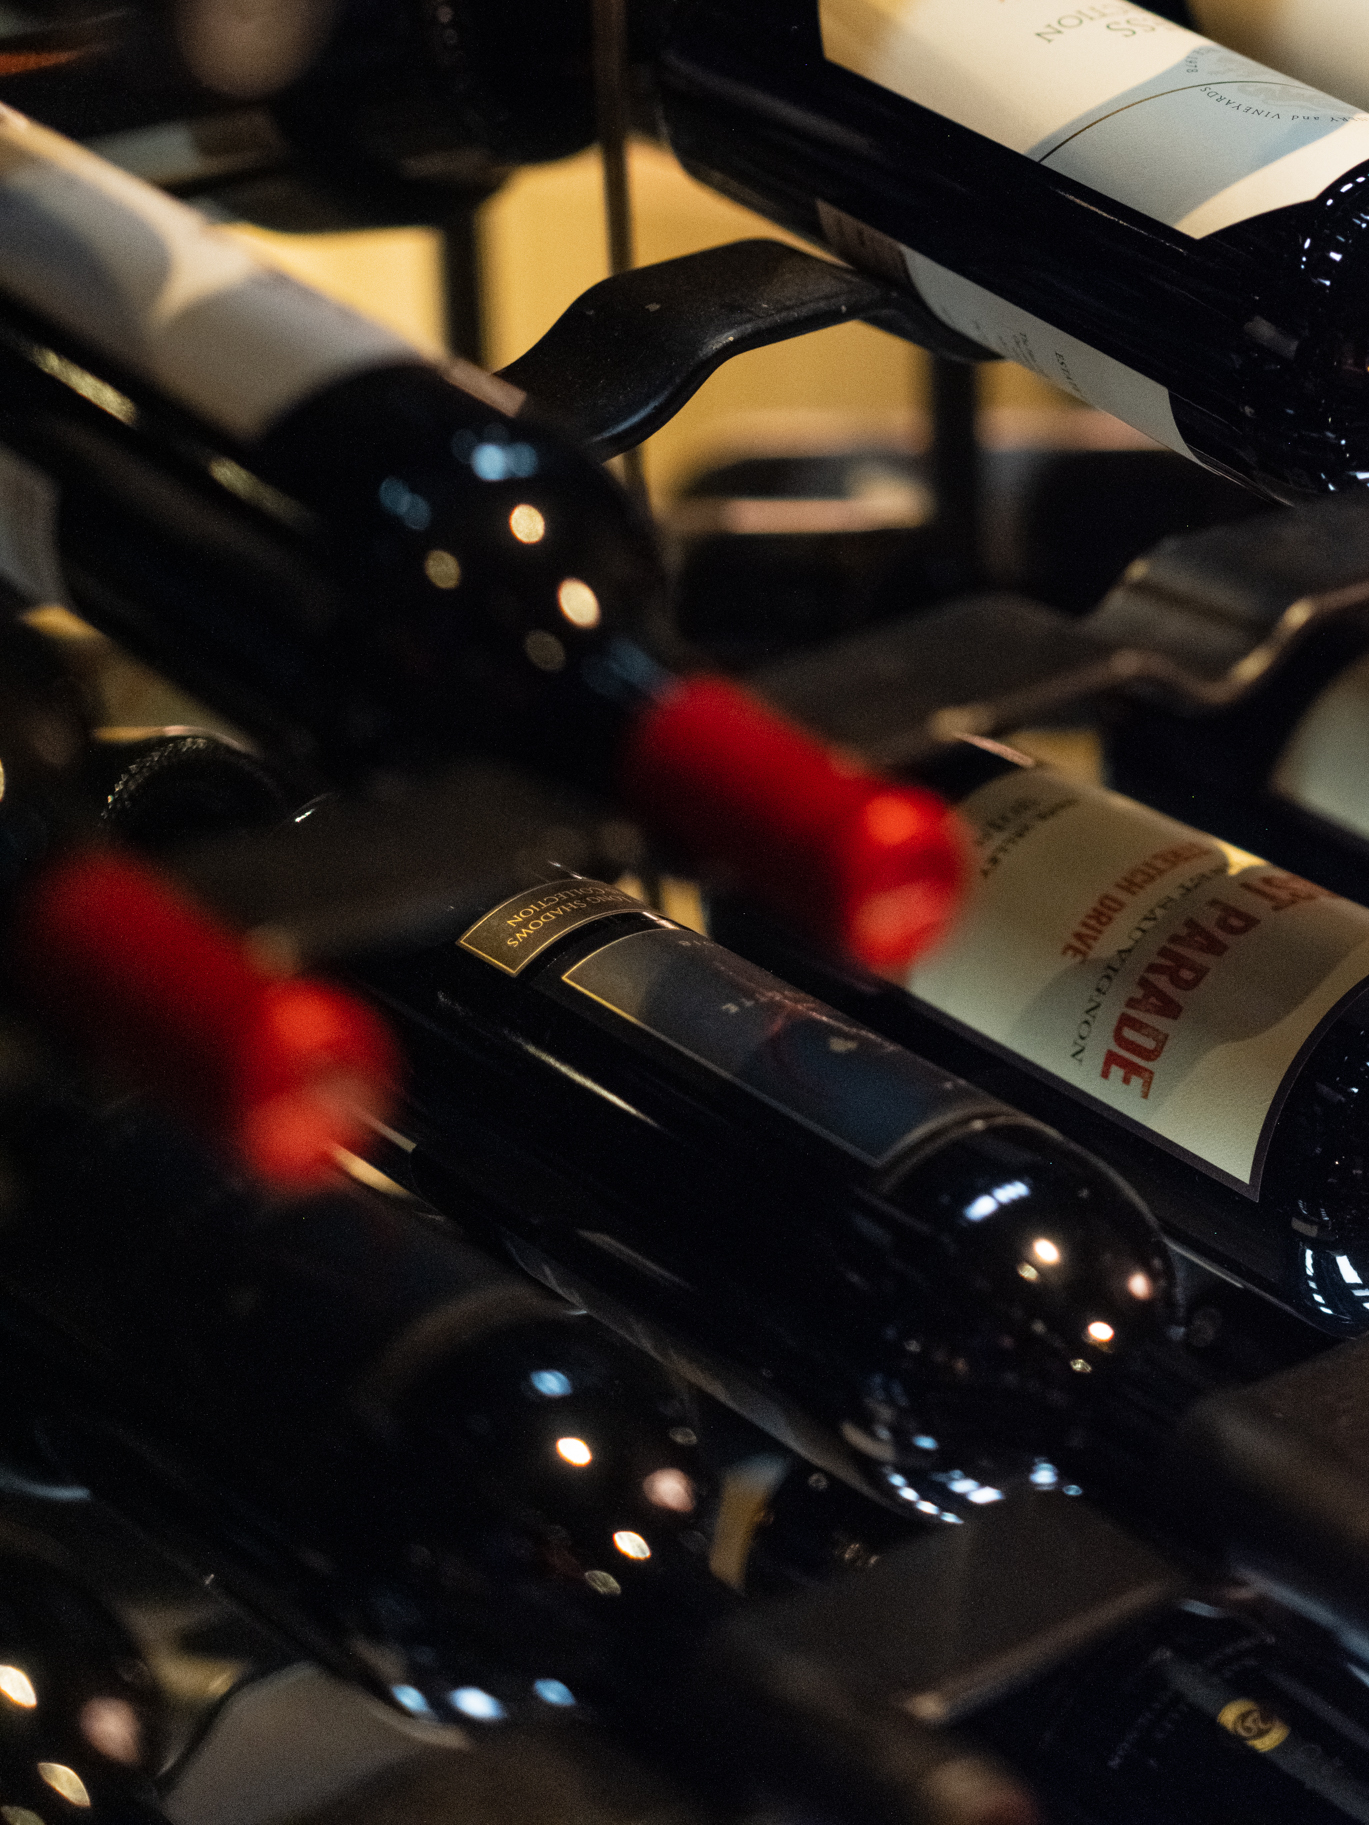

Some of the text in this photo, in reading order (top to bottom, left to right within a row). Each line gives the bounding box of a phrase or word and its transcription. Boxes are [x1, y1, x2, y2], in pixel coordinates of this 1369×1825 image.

[1200, 86, 1281, 120] VINEYARDS
[506, 886, 606, 927] COLLECTION
[507, 899, 587, 948] SHADOWS
[1060, 892, 1128, 965] DRIVE
[1070, 895, 1177, 1065] SAUVIGNON
[1101, 898, 1261, 1100] PARADE
